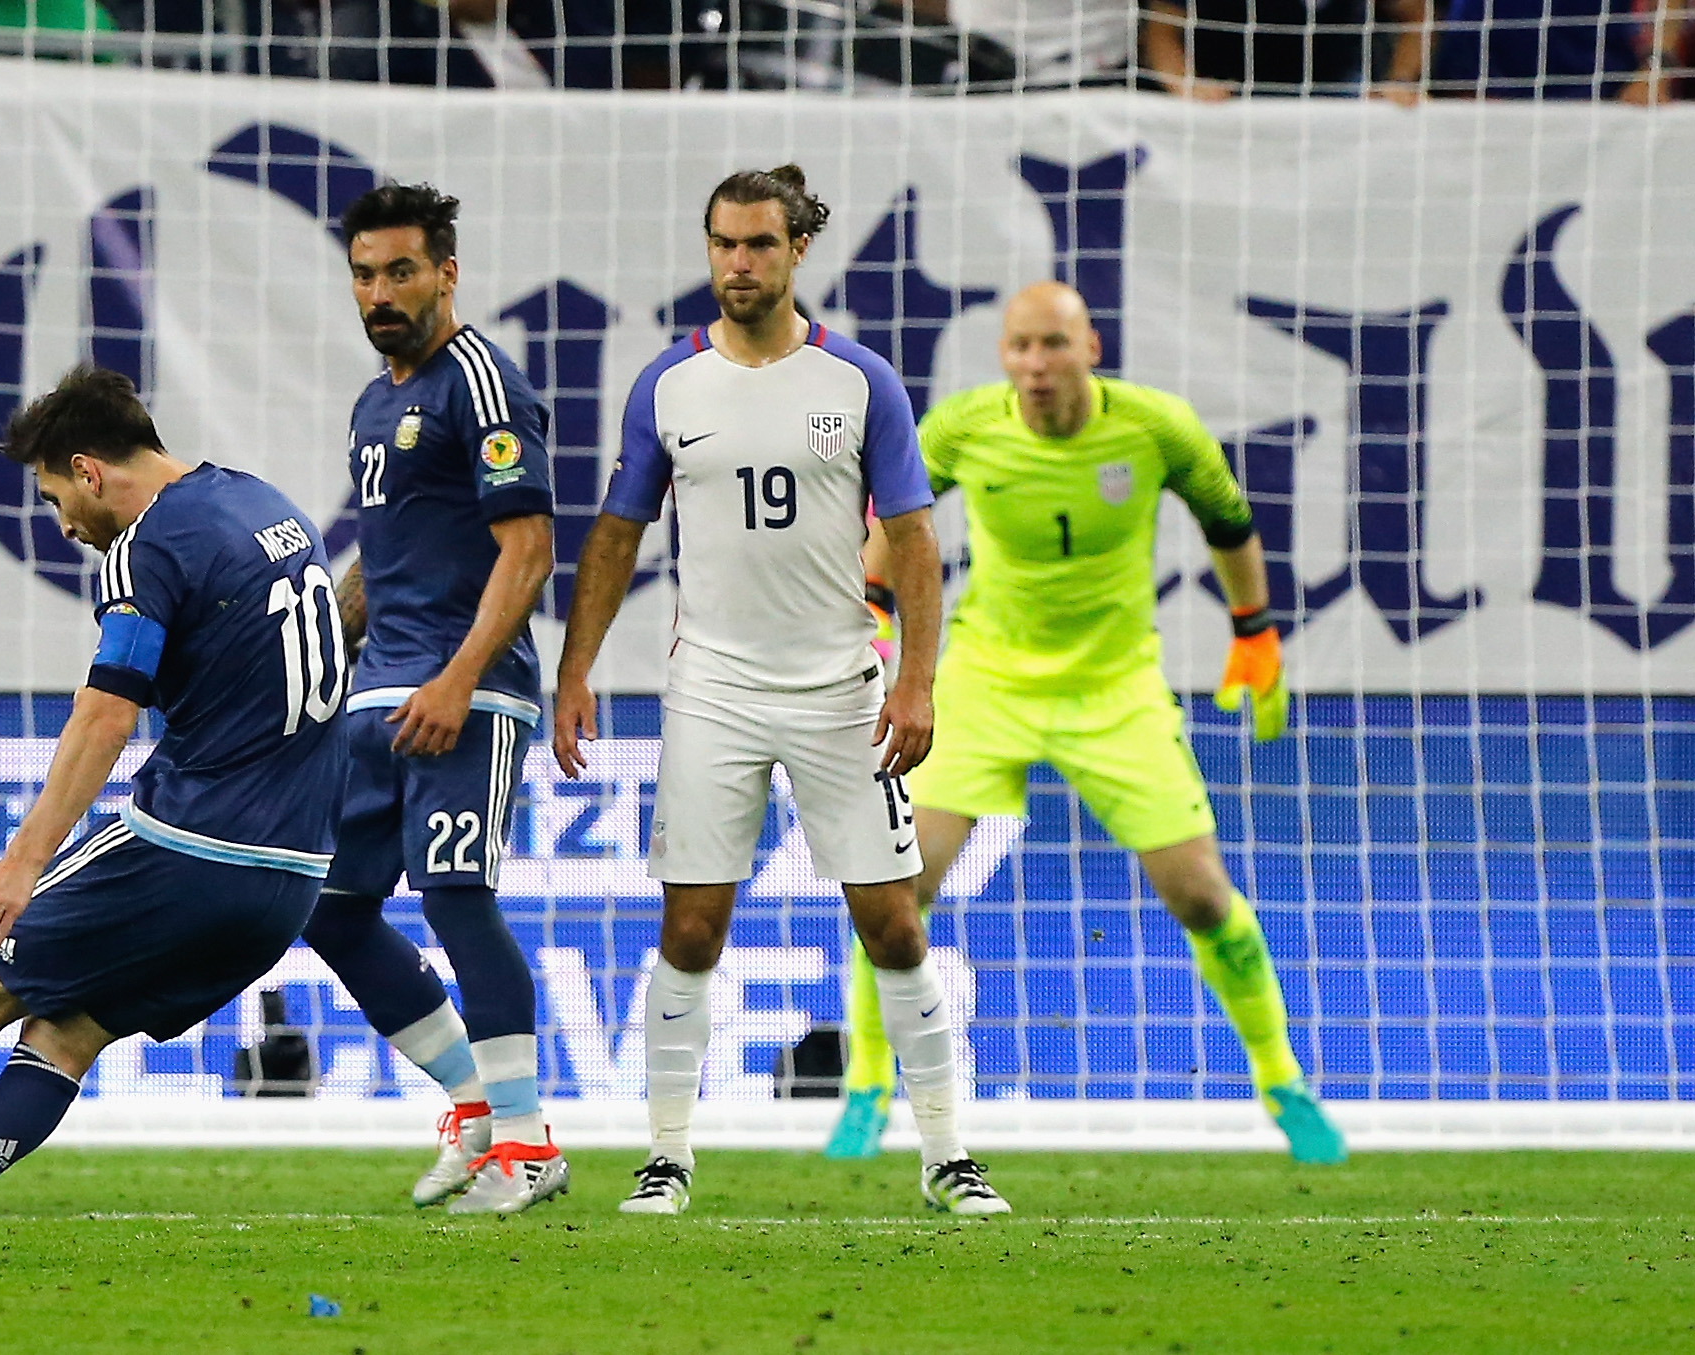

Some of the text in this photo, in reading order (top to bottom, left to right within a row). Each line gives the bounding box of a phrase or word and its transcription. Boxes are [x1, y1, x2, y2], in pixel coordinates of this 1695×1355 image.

[811, 416, 843, 434] USA
[360, 442, 387, 509] 22
[736, 465, 798, 530] 19
[252, 516, 313, 564] MESSI
[1055, 511, 1073, 557] 1
[266, 562, 347, 737] 10
[426, 809, 482, 875] 22
